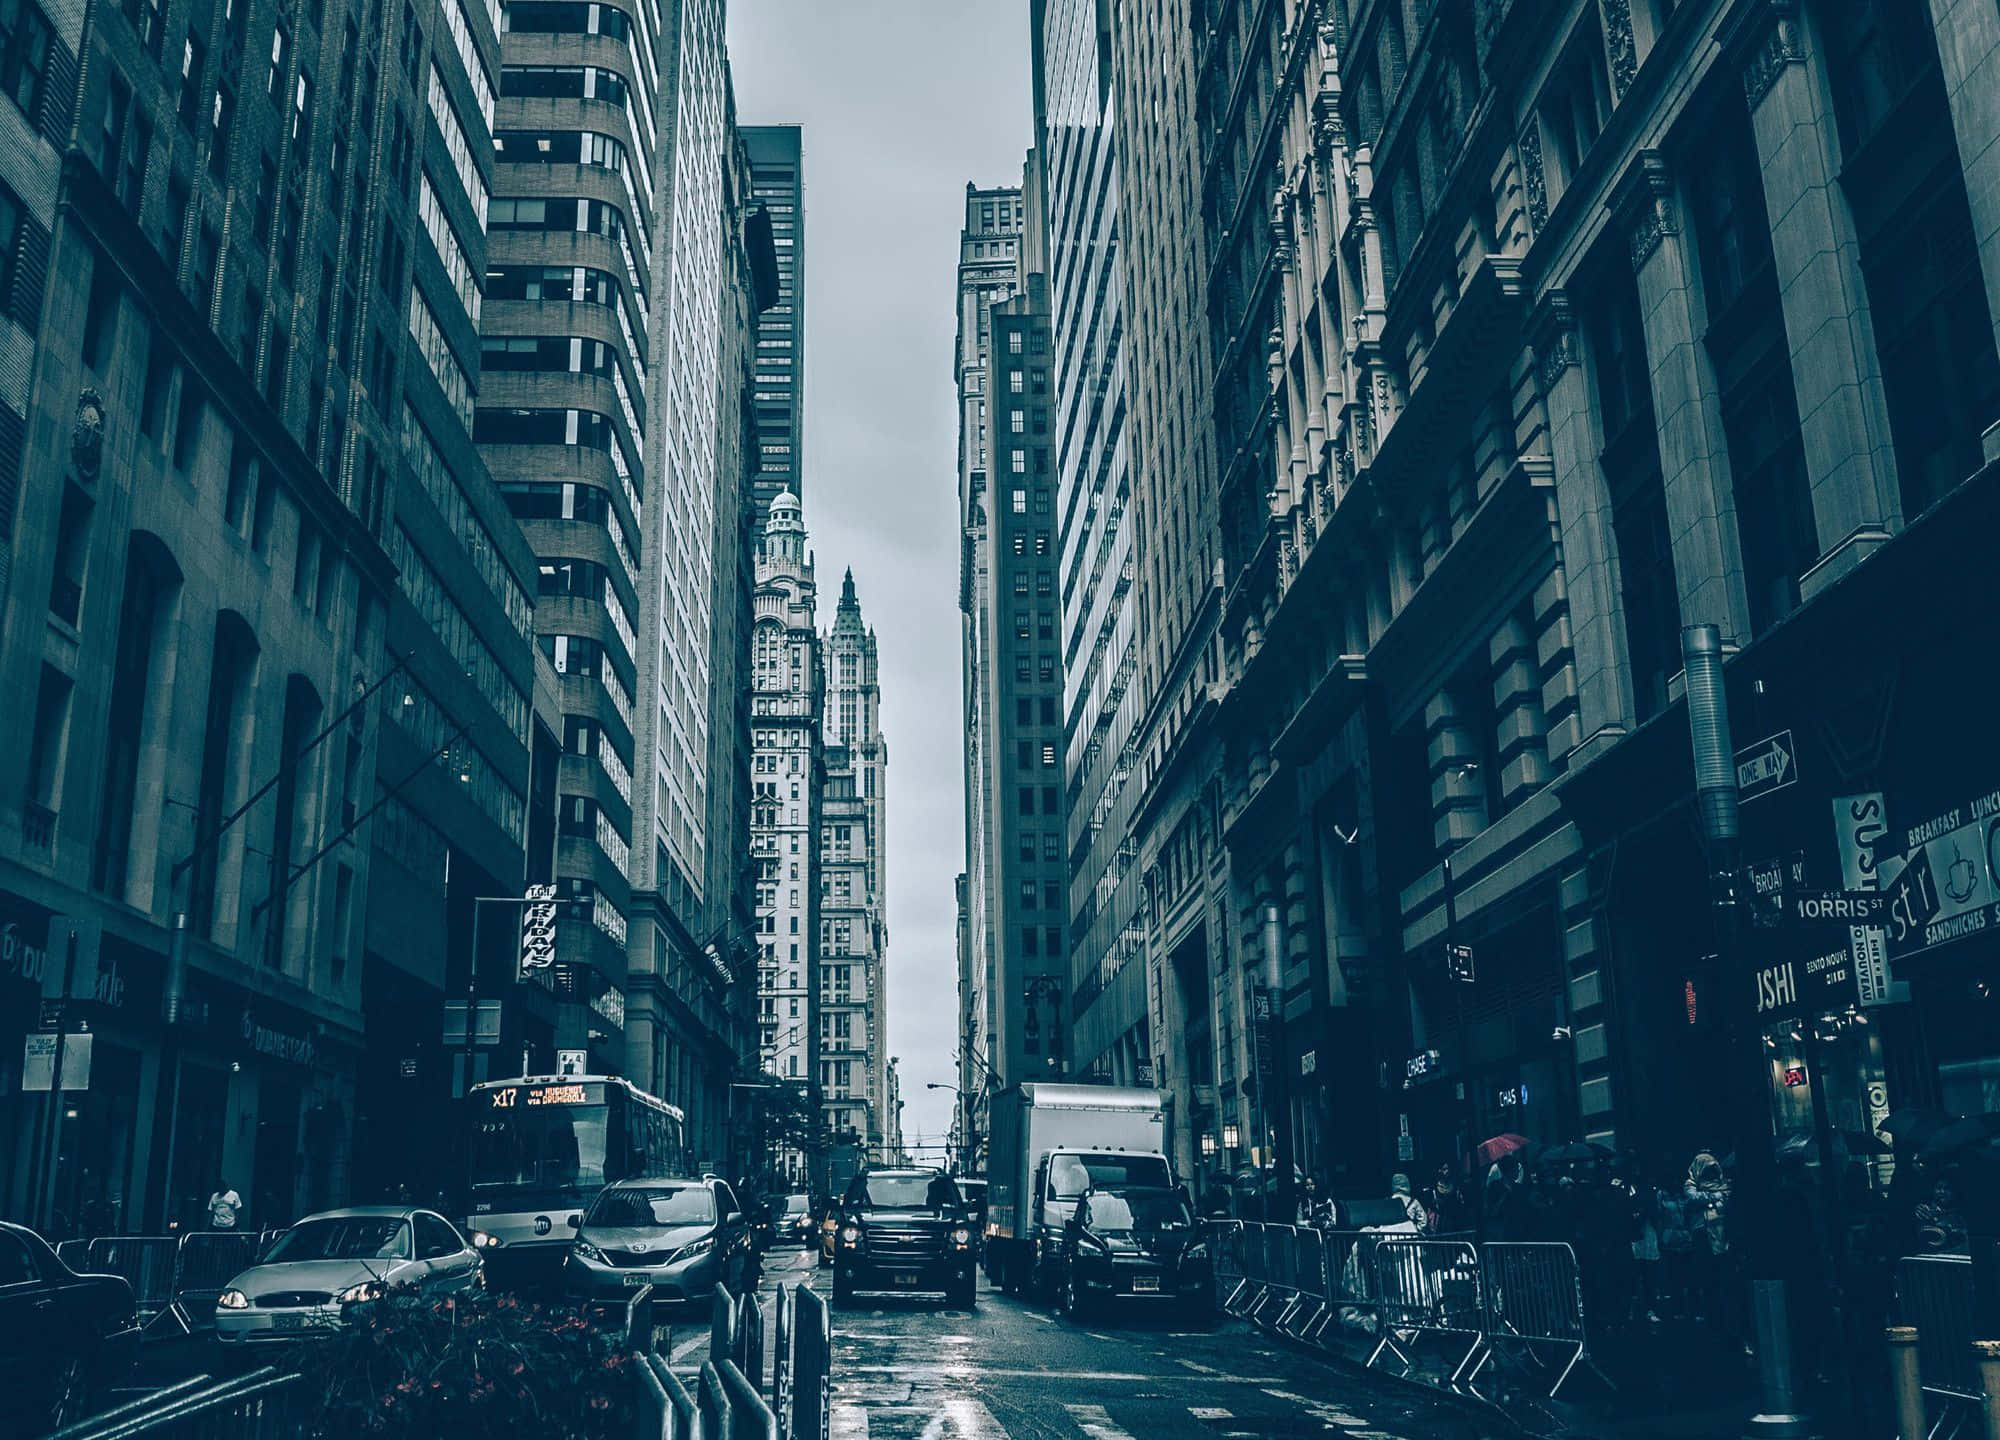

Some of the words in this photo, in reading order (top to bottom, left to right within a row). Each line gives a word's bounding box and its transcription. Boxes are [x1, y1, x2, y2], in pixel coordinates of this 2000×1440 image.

[1741, 761, 1757, 786] ONE
[1763, 750, 1784, 778] WAY
[1908, 808, 1961, 847] BREAKFAST
[1871, 899, 1883, 909] ST
[1925, 908, 1986, 946] SANDWICHES
[710, 952, 735, 984] Fidelity
[1855, 942, 1873, 1000] NOUVEAU
[1407, 1053, 1428, 1078] CHASE
